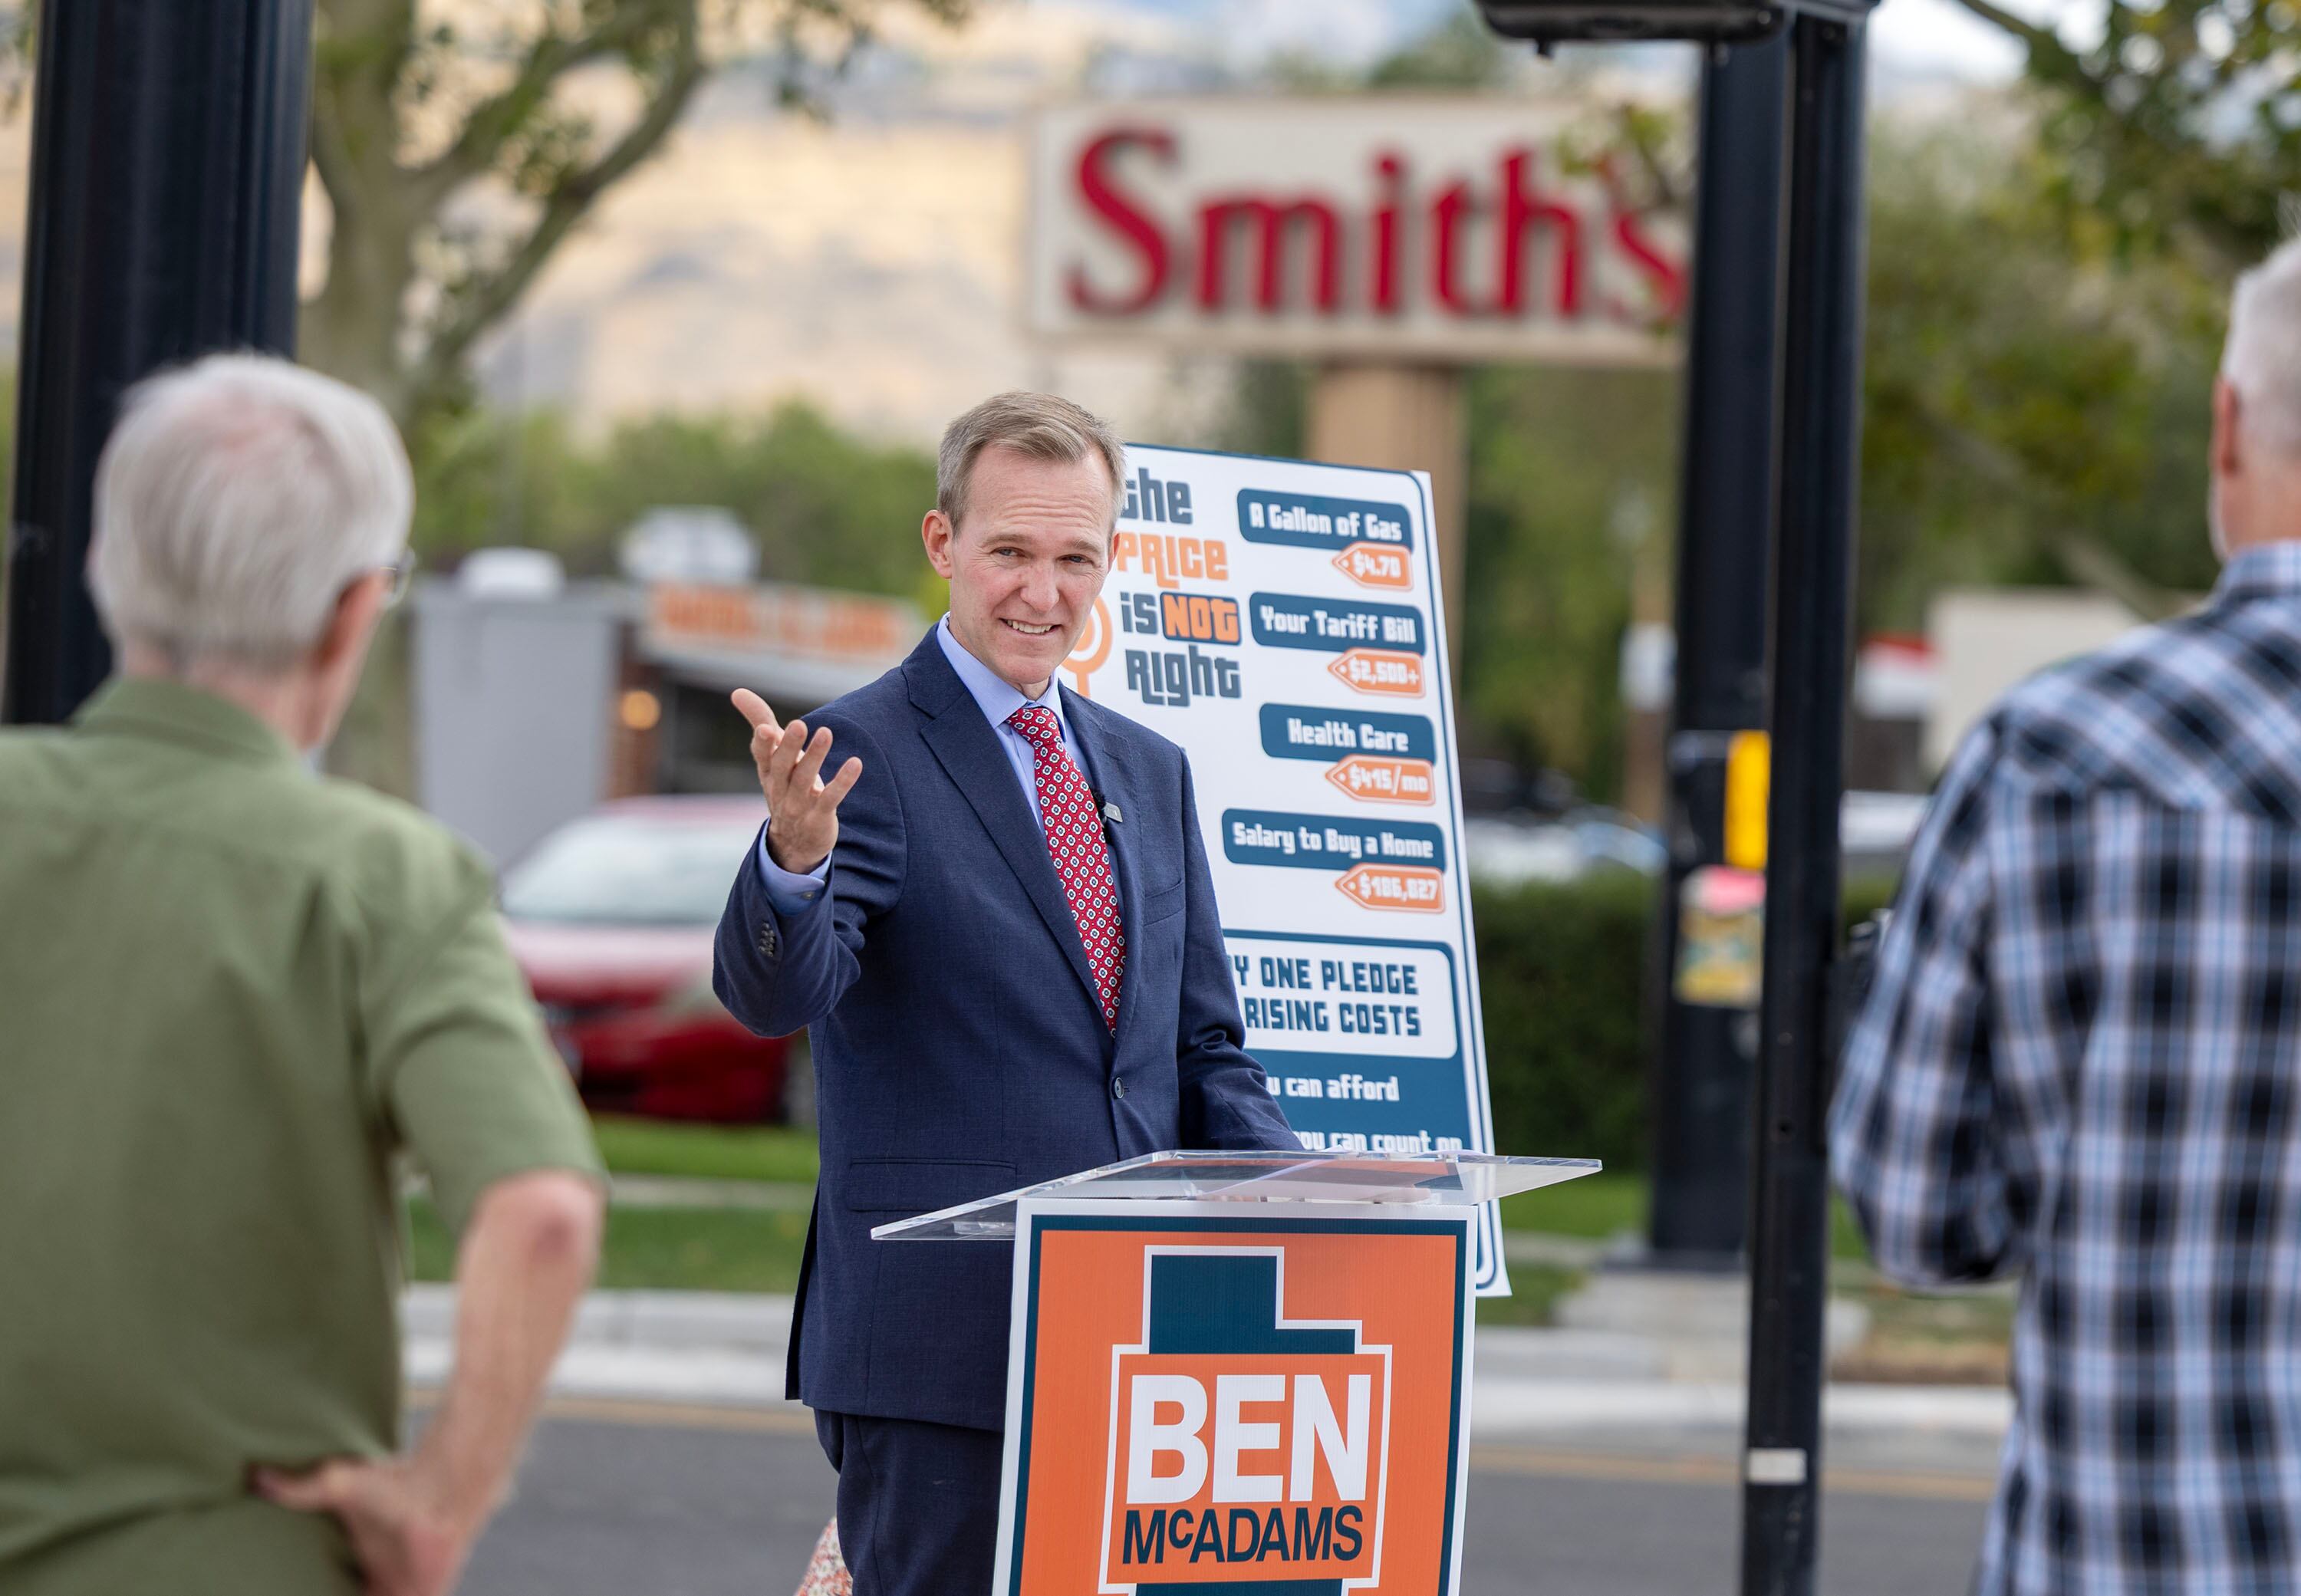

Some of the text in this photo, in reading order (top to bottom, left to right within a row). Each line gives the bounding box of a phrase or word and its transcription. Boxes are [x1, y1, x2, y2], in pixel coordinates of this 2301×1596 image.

[1249, 502, 1403, 541] A Gallon of Gas
[1259, 604, 1417, 644] Your Tariff Bill
[1287, 717, 1409, 752] Health Care
[1233, 821, 1434, 859] Salary to Buy a Home
[1227, 955, 1419, 995] Y ONE PLEDGE
[1244, 997, 1421, 1037] RISING COSTS
[1285, 1077, 1323, 1098] can
[1327, 1074, 1400, 1101] afford
[1329, 1132, 1368, 1152] can
[1371, 1130, 1432, 1153] count
[1436, 1137, 1463, 1151] on
[1126, 1374, 1371, 1504] BEN
[1122, 1505, 1364, 1565] McADAMS
